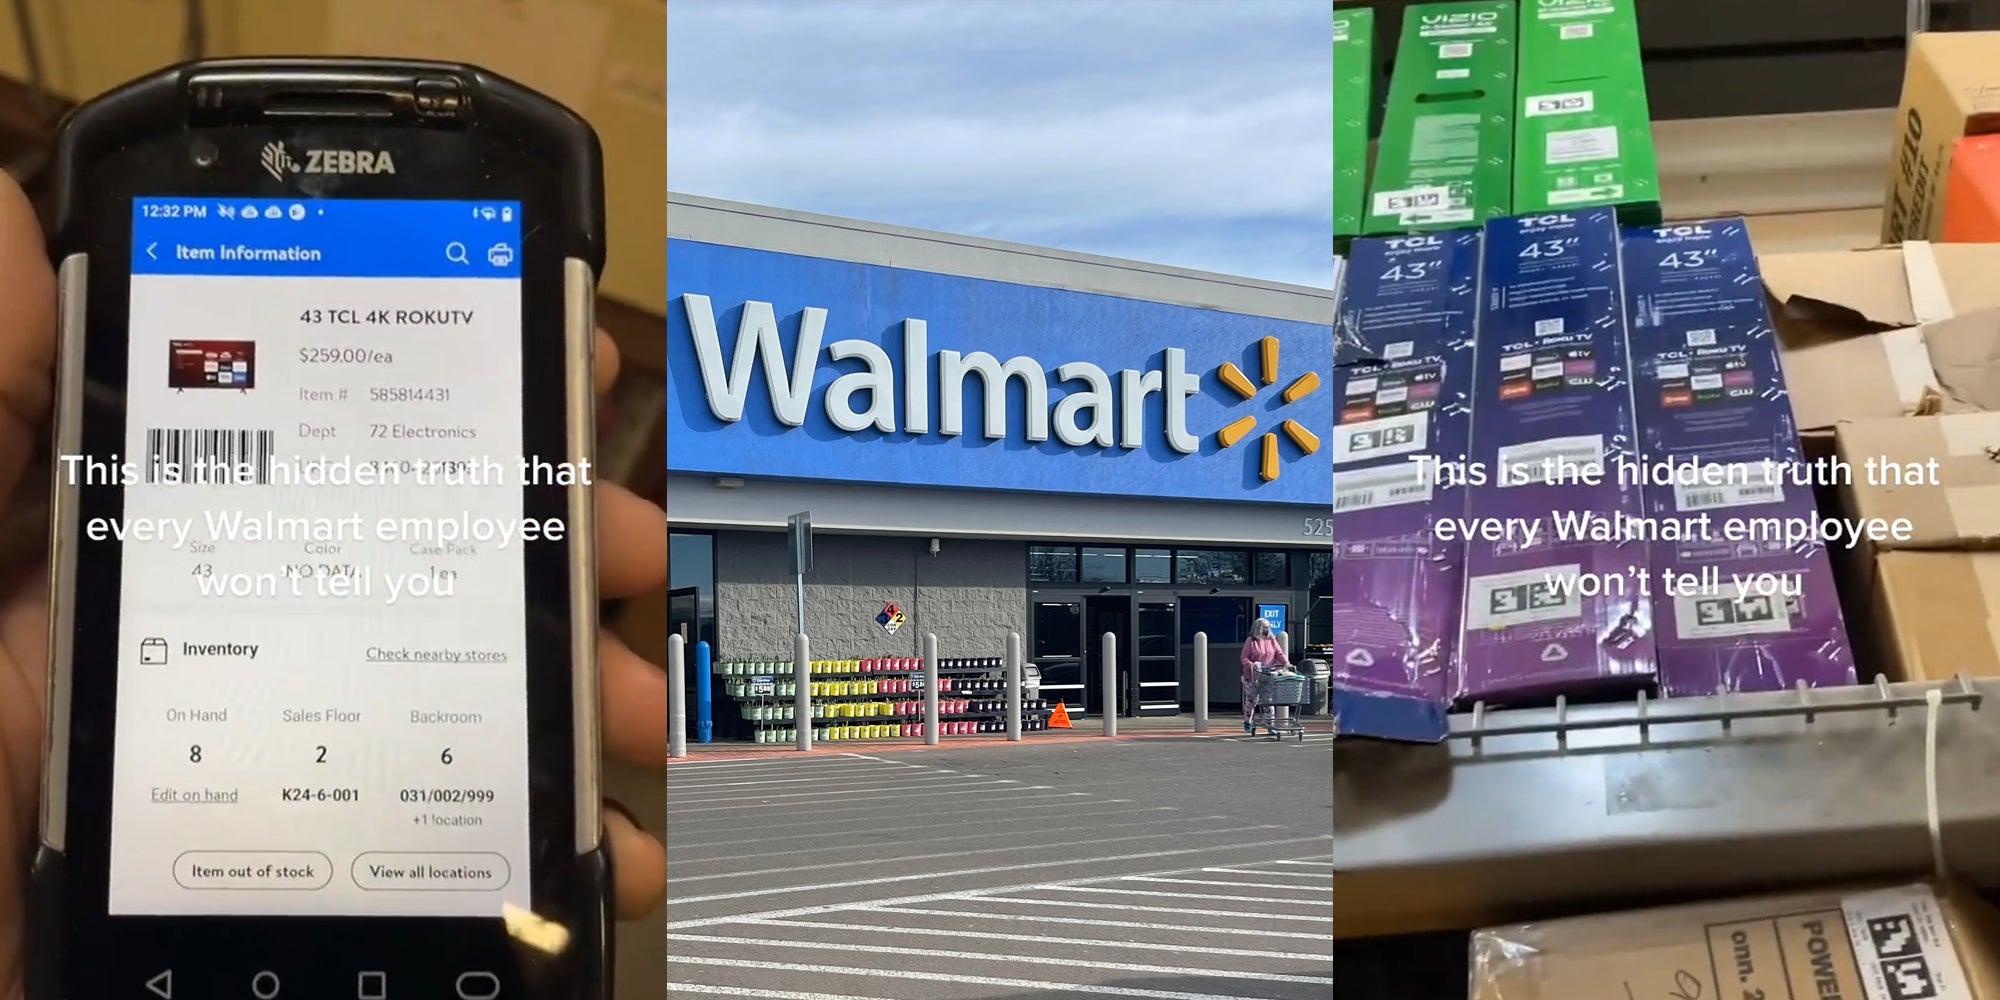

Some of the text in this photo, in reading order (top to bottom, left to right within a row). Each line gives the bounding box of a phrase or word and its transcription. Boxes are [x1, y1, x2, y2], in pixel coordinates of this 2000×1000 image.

[1422, 12, 1497, 24] VIZIO
[304, 150, 396, 174] ZEBRA
[142, 204, 207, 218] 12:32 PM
[1518, 214, 1576, 228] TCL
[1653, 225, 1712, 238] TCL
[1385, 235, 1443, 249] TCL
[176, 244, 322, 261] Item Information
[300, 310, 474, 325] 43 TCL 4K ROKUTV
[1502, 341, 1533, 351] TCL
[1576, 333, 1593, 341] TV
[299, 347, 393, 364] $259.00/ea
[1656, 350, 1688, 360] TCL
[1729, 344, 1746, 352] TV
[1350, 364, 1382, 375] TCL
[1424, 354, 1441, 364] TV
[682, 293, 1200, 454] Walmart
[299, 387, 450, 402] Item # 585814431
[299, 423, 477, 441] Dept 72 Electronics
[190, 541, 215, 554] Size
[304, 542, 341, 555] Color
[409, 544, 478, 556] Case Pack
[887, 604, 895, 615] 4
[1264, 609, 1280, 618] EXIT
[896, 613, 903, 622] 2
[1269, 620, 1282, 628] NLY
[182, 642, 259, 660] Inventory
[366, 647, 508, 664] Check nearby stores
[166, 708, 227, 722] On Hand
[282, 709, 361, 722] Sales Floor
[410, 710, 482, 724] Backroom
[189, 744, 202, 763] 8
[315, 745, 327, 763] 2
[441, 747, 453, 765] 6
[151, 788, 238, 802] Edit on hand
[282, 788, 359, 802] K24-6-001
[400, 789, 495, 803] 031/002/999
[413, 813, 482, 826] +1 location
[192, 864, 314, 878] Item out of stock
[369, 865, 492, 880] View all locations
[1731, 930, 1755, 984] onn.
[1802, 920, 1842, 1000] POWE
